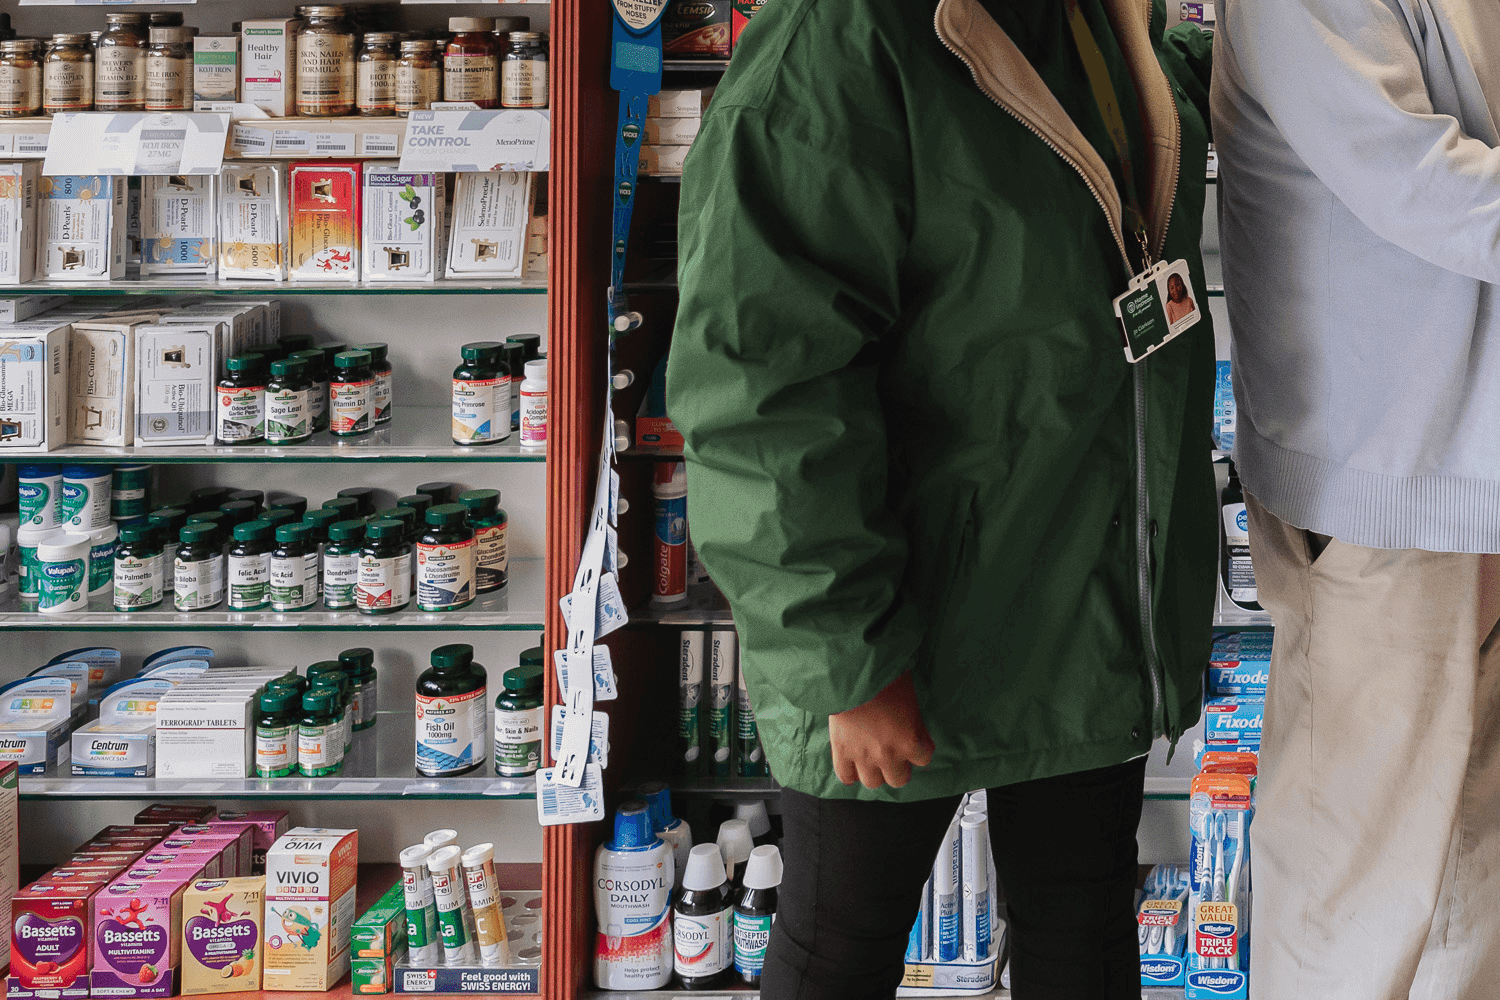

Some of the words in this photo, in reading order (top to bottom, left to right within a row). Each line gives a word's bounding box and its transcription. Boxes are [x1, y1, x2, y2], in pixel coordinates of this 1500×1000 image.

[616, 0, 633, 10] FROM
[634, 4, 657, 14] STUFFY
[626, 9, 647, 20] NOSES
[247, 44, 279, 54] Healthy
[254, 52, 272, 60] Hair
[411, 125, 445, 135] TAKE
[409, 136, 471, 147] CONTROL
[496, 138, 535, 146] MenoPrime
[370, 175, 390, 183] Blood
[392, 176, 412, 184] Sugar
[478, 176, 490, 226] SelenoPrecise
[62, 206, 71, 240] D-Pearls
[88, 346, 96, 395] Bio-Culture
[271, 406, 286, 414] Sage
[287, 404, 302, 413] Leaf
[48, 567, 75, 577] Valupak
[254, 567, 266, 575] Acid
[426, 564, 460, 573] Glucosamine
[658, 545, 669, 595] Colgate
[124, 572, 152, 581] Palmetto
[430, 571, 460, 579] Chondroitin
[681, 639, 690, 681] Steradent
[426, 723, 441, 732] Fish
[443, 722, 455, 731] Oil
[428, 731, 452, 739] 1000mg
[91, 740, 129, 751] Centrum
[276, 871, 320, 884] VIVIO
[597, 877, 666, 892] CORSODYL
[153, 897, 168, 905] 7-11
[610, 893, 649, 903] DAILY
[1200, 905, 1234, 914] GREAT
[1200, 913, 1233, 922] VALUE
[22, 925, 76, 939] Bassetts
[192, 924, 250, 940] Bassetts
[1204, 925, 1231, 933] Wisdom
[104, 930, 160, 943] Bassetts
[1199, 938, 1233, 947] TRIPLE
[1200, 946, 1233, 955] PACK
[461, 972, 481, 981] Feel
[483, 973, 508, 983] good
[510, 972, 530, 981] with
[956, 973, 991, 983] Steradent
[1198, 975, 1238, 985] Wisdom
[461, 982, 487, 991] SWISS
[489, 982, 531, 991] ENERGY!
